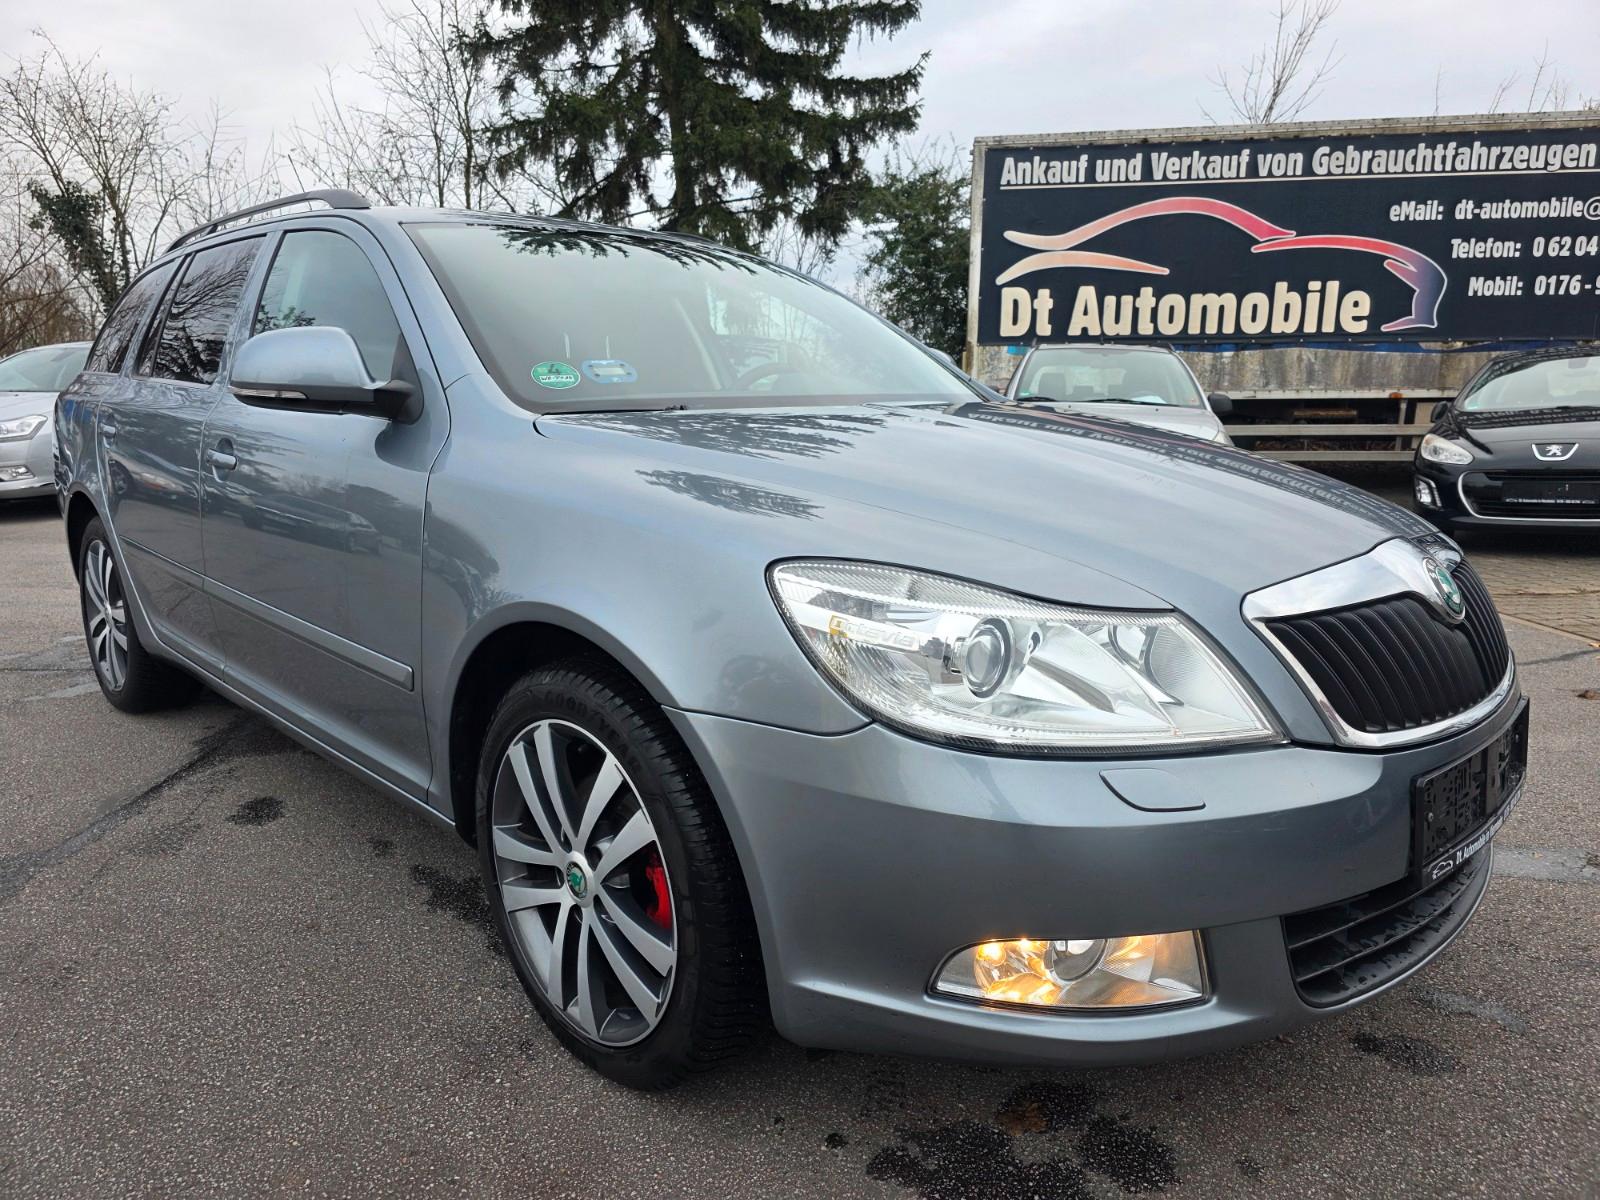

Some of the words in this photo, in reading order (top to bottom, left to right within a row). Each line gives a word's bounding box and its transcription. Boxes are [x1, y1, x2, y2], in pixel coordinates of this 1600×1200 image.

[1000, 154, 1088, 186] Ankauf
[1095, 153, 1143, 182] und
[1150, 150, 1250, 181] Verkauf
[1257, 151, 1304, 177] von
[1312, 141, 1597, 176] Gebrauchtfahrzeugen
[1390, 200, 1444, 222] eMail:
[1450, 237, 1522, 259] Telefon:
[1467, 275, 1524, 297] Mobil:
[1534, 274, 1582, 296] 0176
[1000, 286, 1054, 337] Dt
[1067, 281, 1371, 336] Automobile
